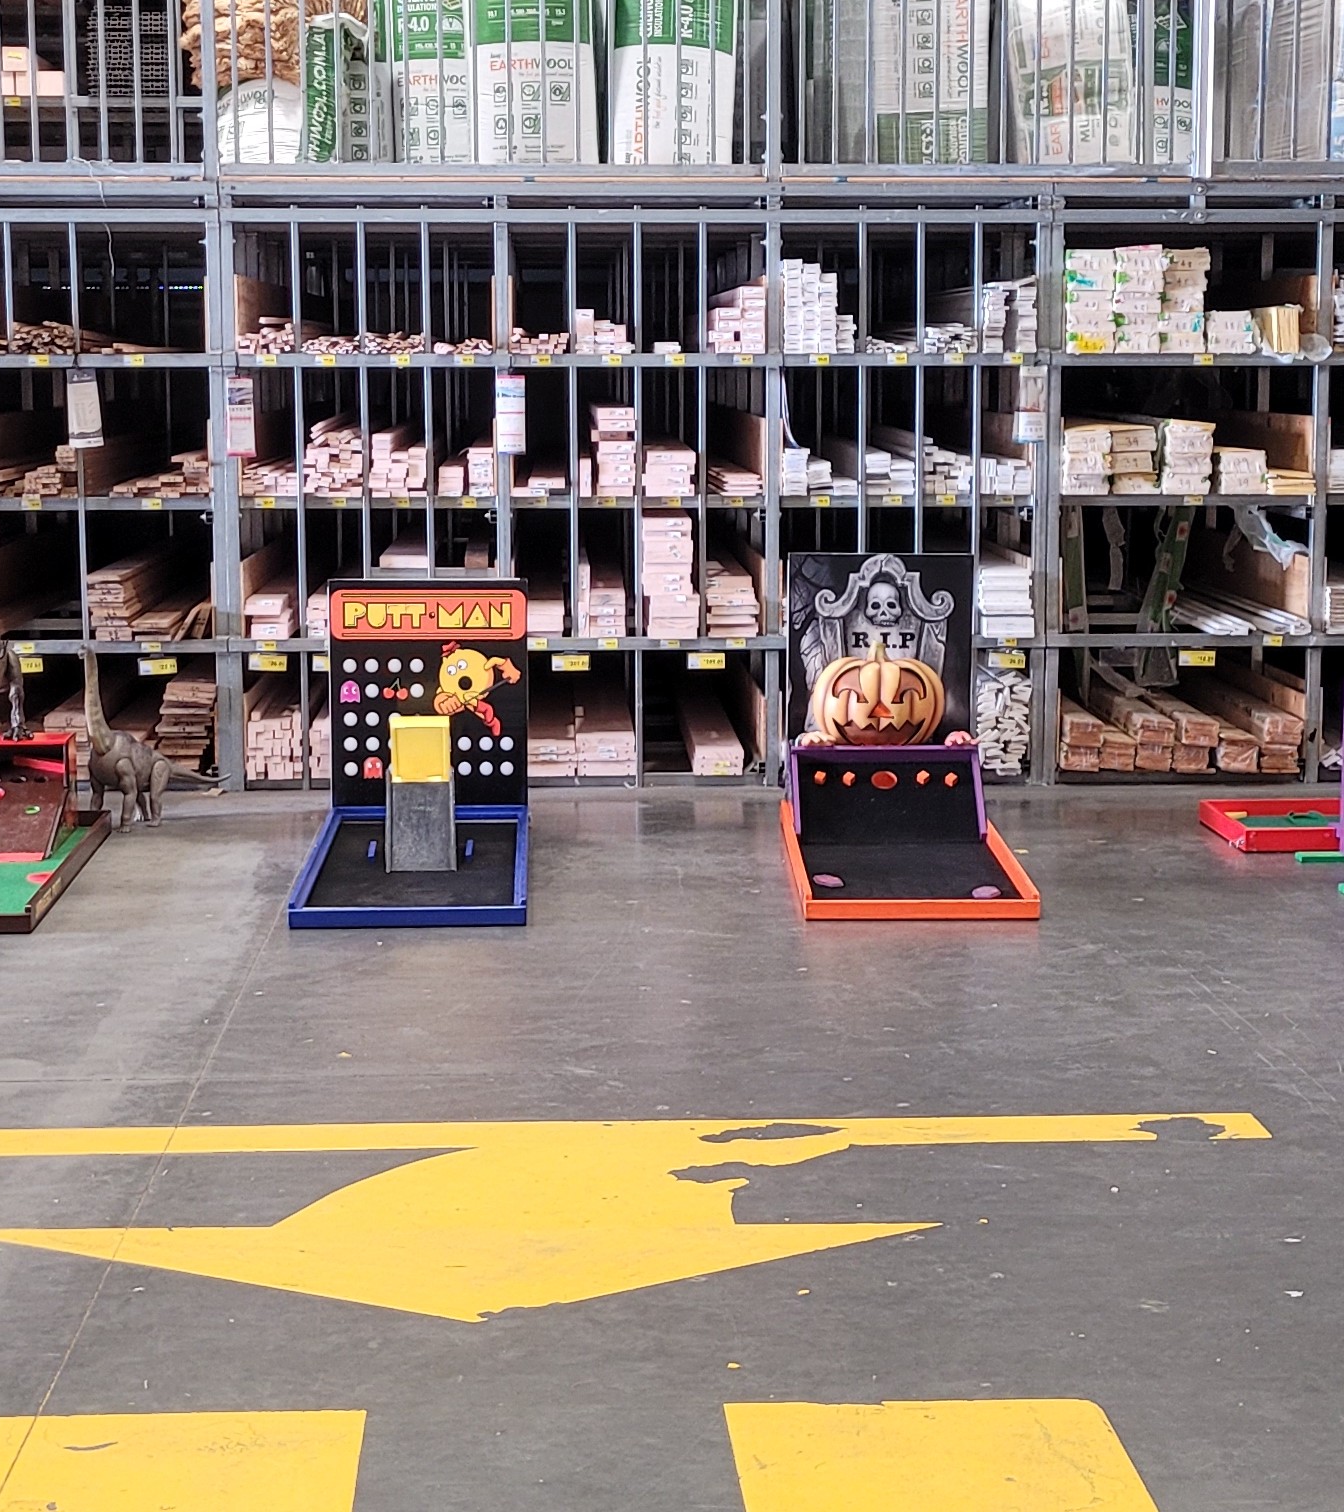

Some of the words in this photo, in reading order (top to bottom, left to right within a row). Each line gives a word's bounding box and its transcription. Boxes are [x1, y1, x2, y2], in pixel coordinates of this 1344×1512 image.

[955, 0, 969, 97] ARTHWOOL
[490, 57, 573, 71] EARTHWOOL
[398, 74, 467, 88] EARTHWOO
